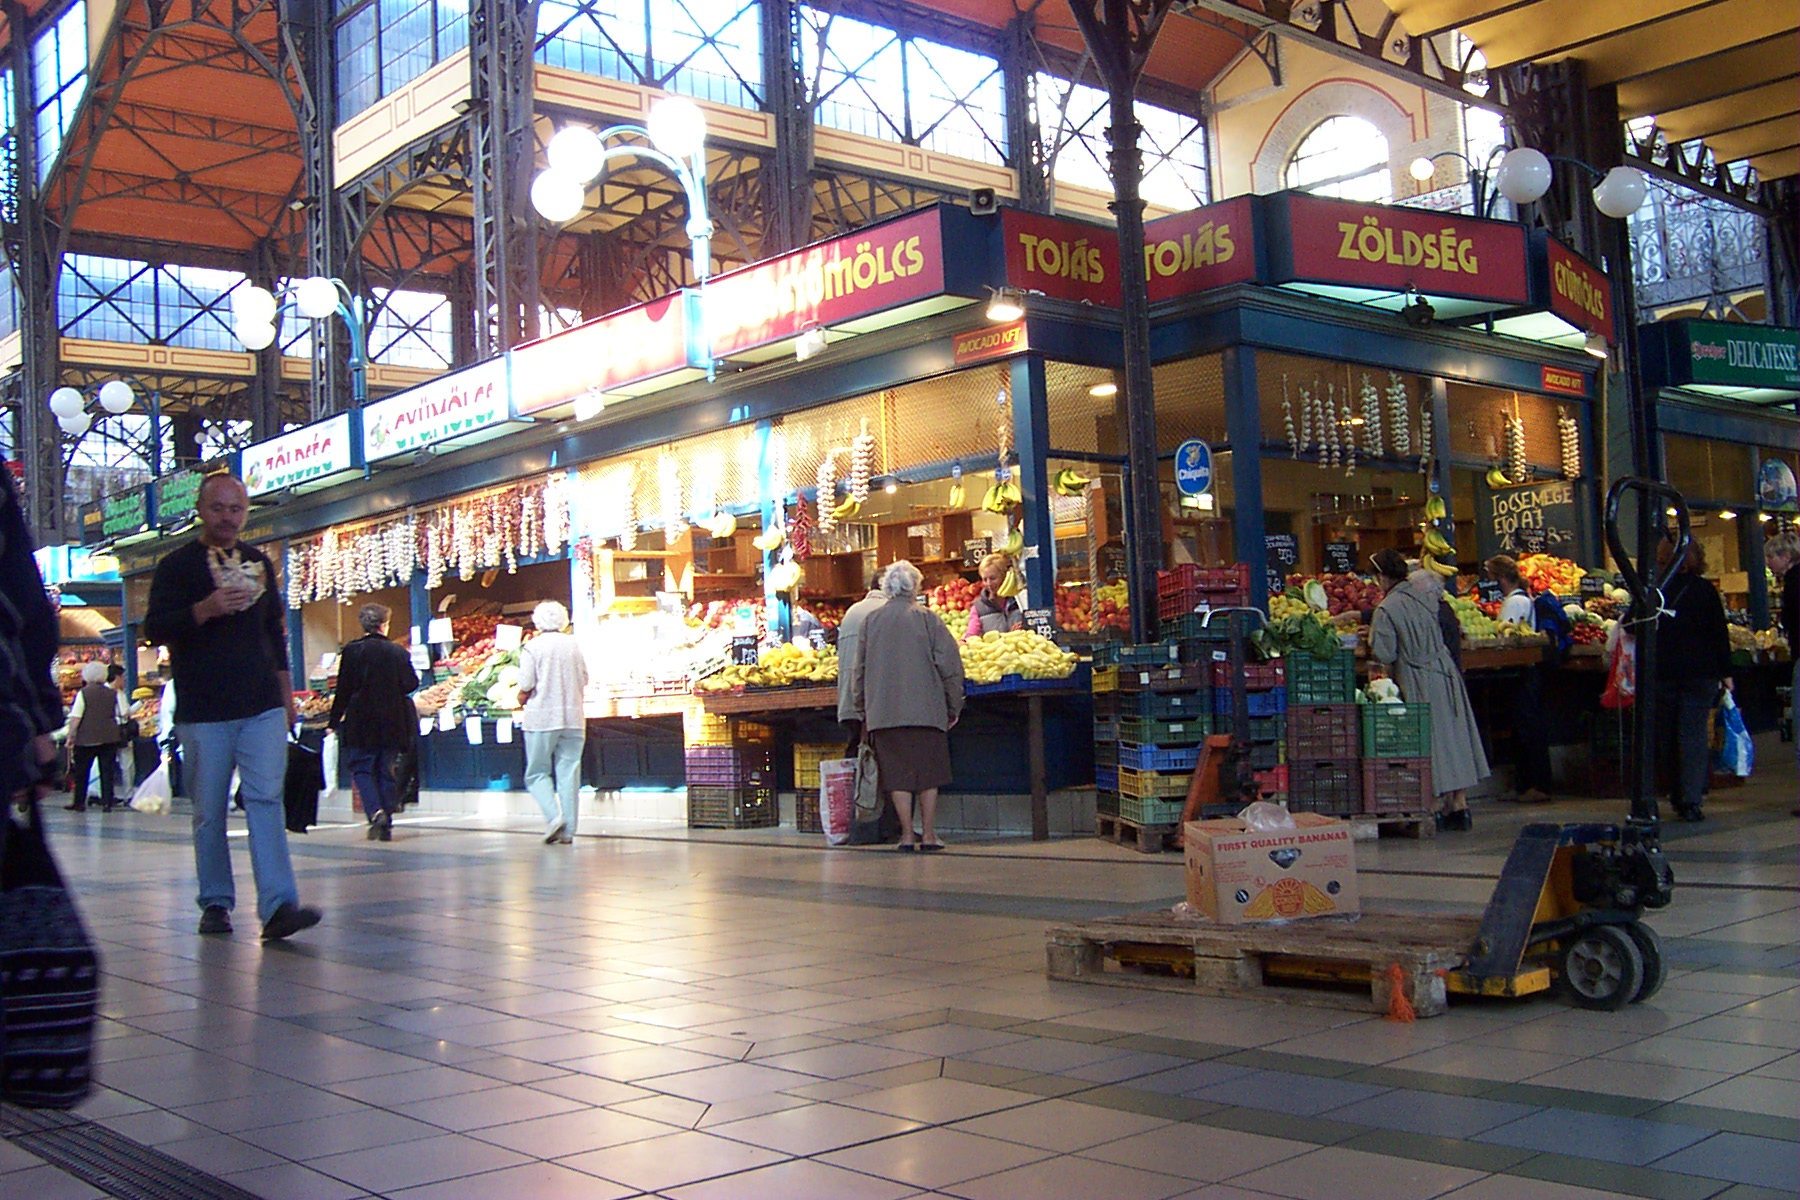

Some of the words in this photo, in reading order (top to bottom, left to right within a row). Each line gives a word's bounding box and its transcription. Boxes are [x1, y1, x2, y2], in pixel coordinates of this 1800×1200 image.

[1019, 233, 1105, 283] TOJÁS
[1338, 215, 1478, 274] ZÖLDSÉG
[957, 332, 1001, 355] AVOCADO
[1001, 327, 1021, 344] KFT
[1727, 339, 1798, 371] DELICATESSE
[1217, 841, 1248, 852] FIRST
[1251, 836, 1296, 849] QUALITY
[1298, 831, 1349, 845] BANANAS
